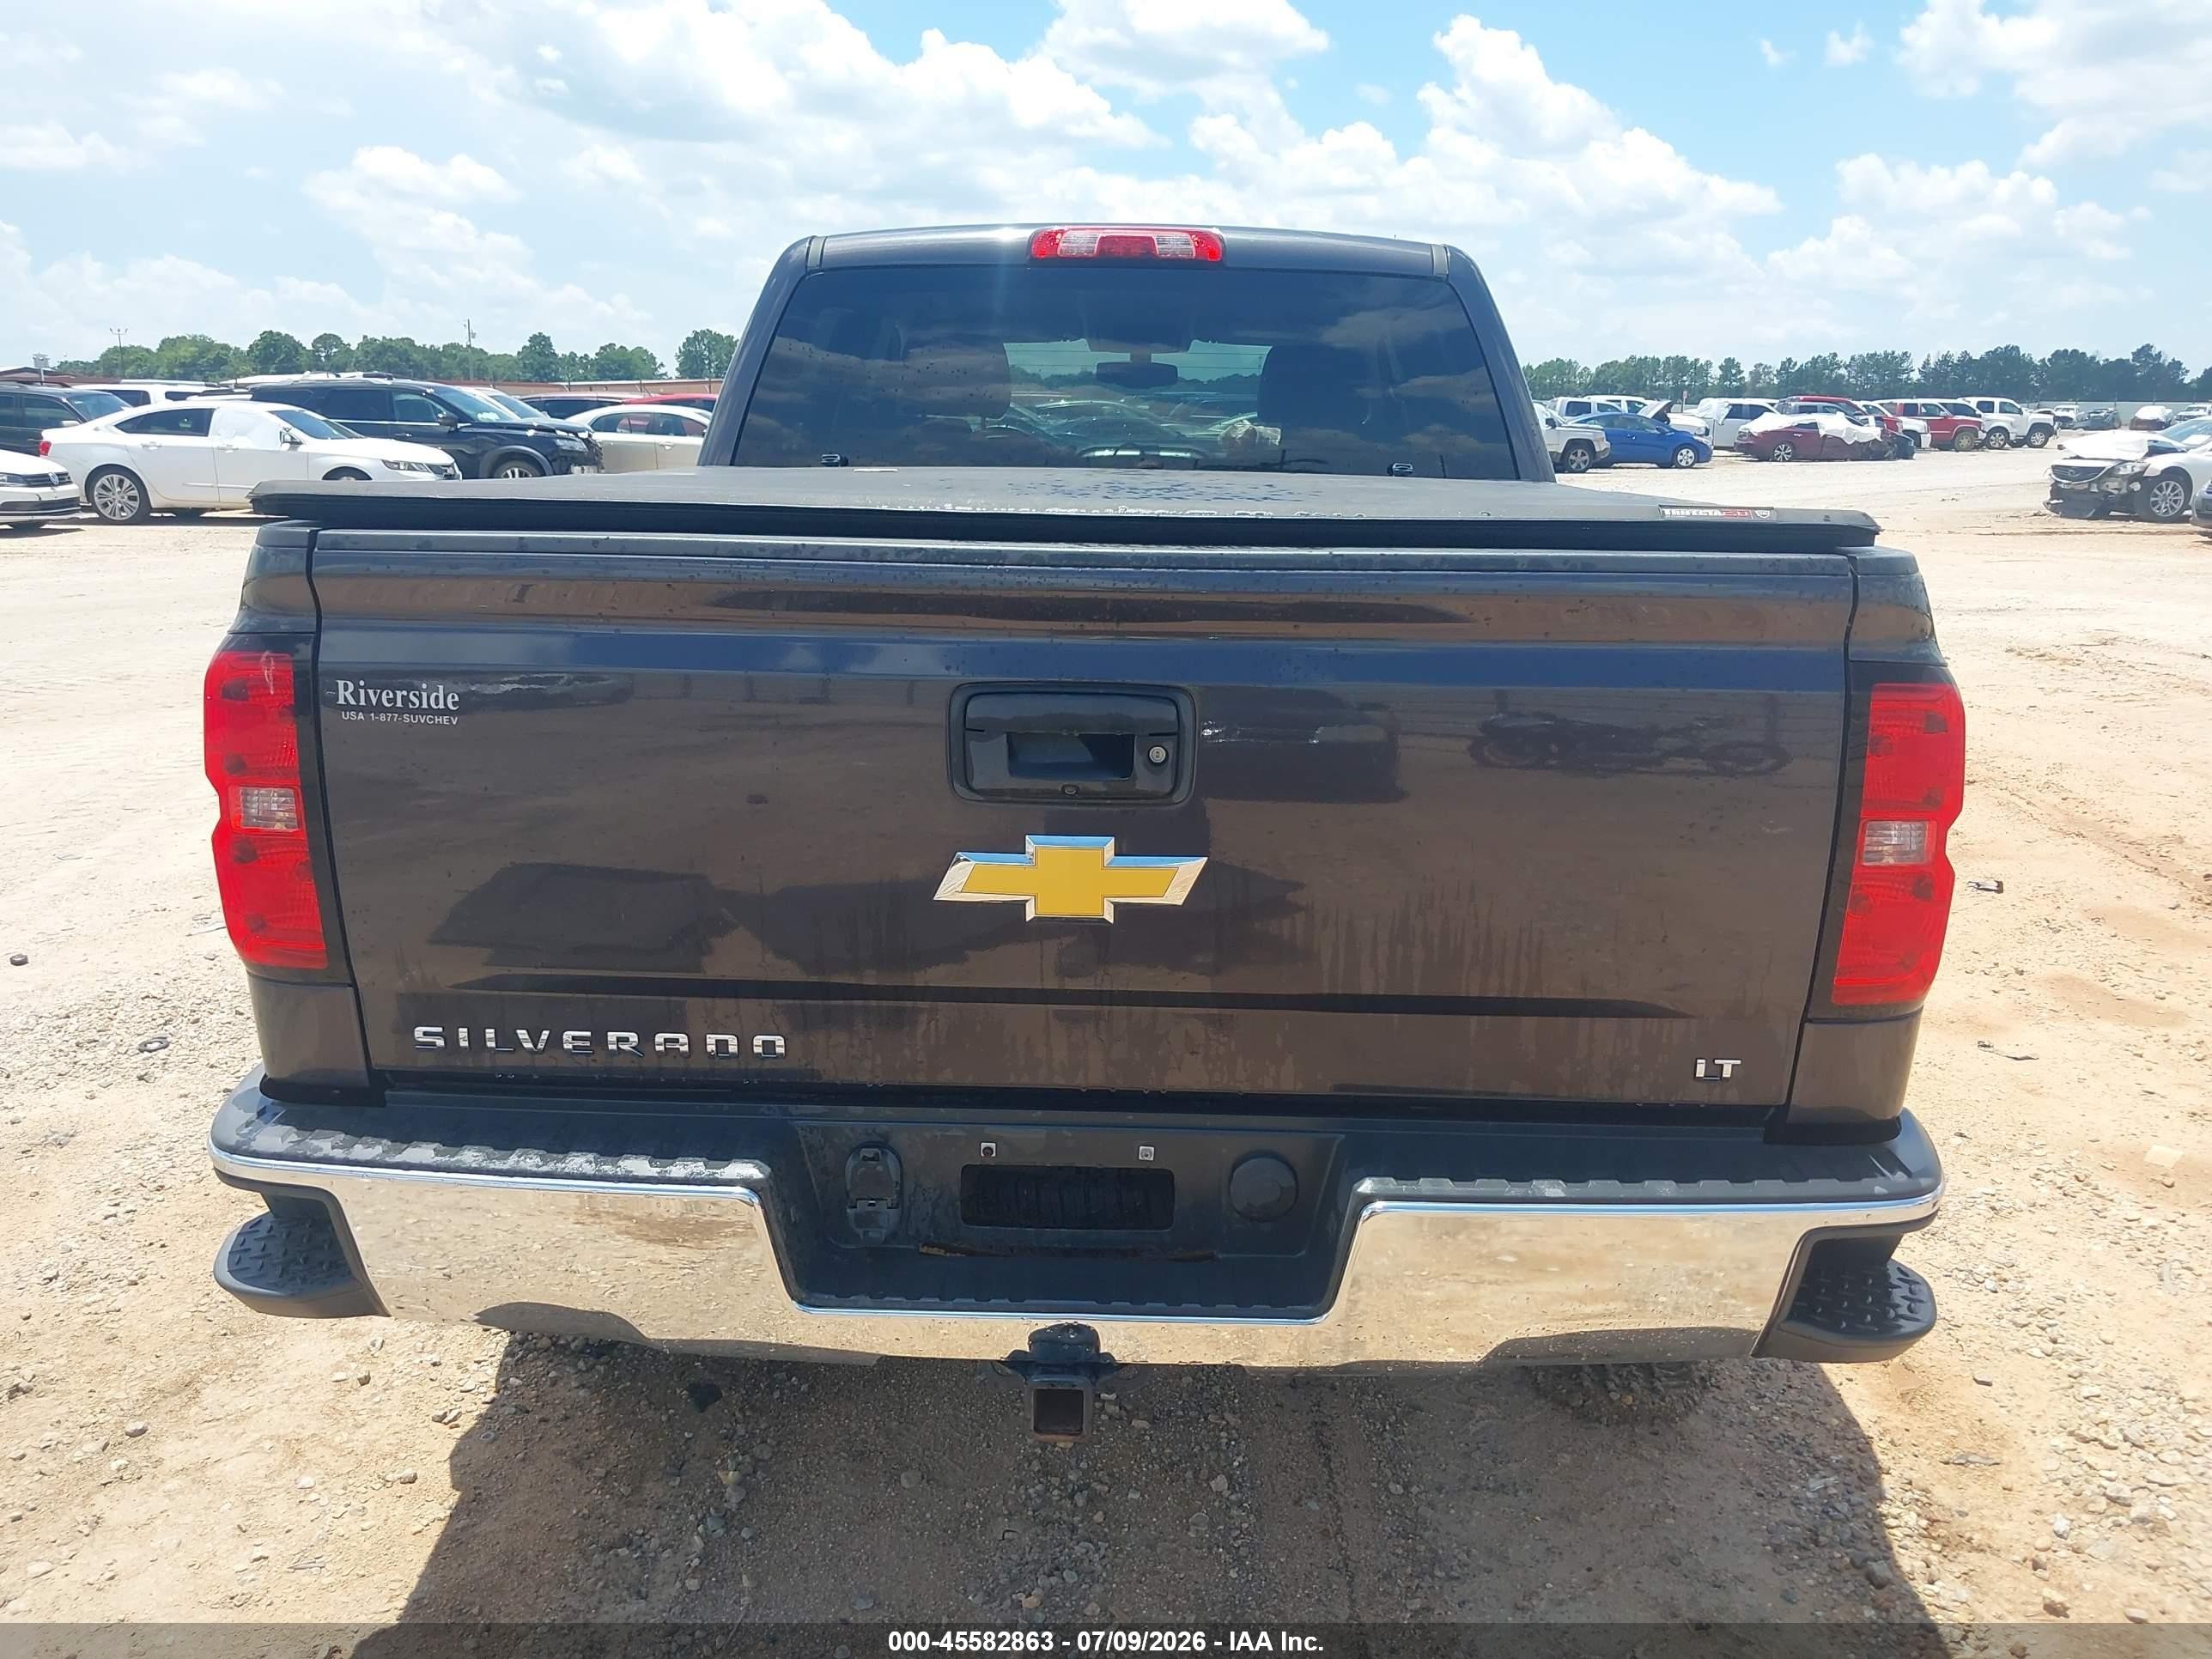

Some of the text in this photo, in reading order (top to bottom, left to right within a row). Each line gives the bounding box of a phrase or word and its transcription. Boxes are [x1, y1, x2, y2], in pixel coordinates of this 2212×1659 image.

[336, 680, 459, 710] Riverside
[342, 711, 459, 725] USA 1-877-SUVCHEV
[413, 1026, 786, 1057] SILVERADO
[1695, 1058, 1742, 1080] LT
